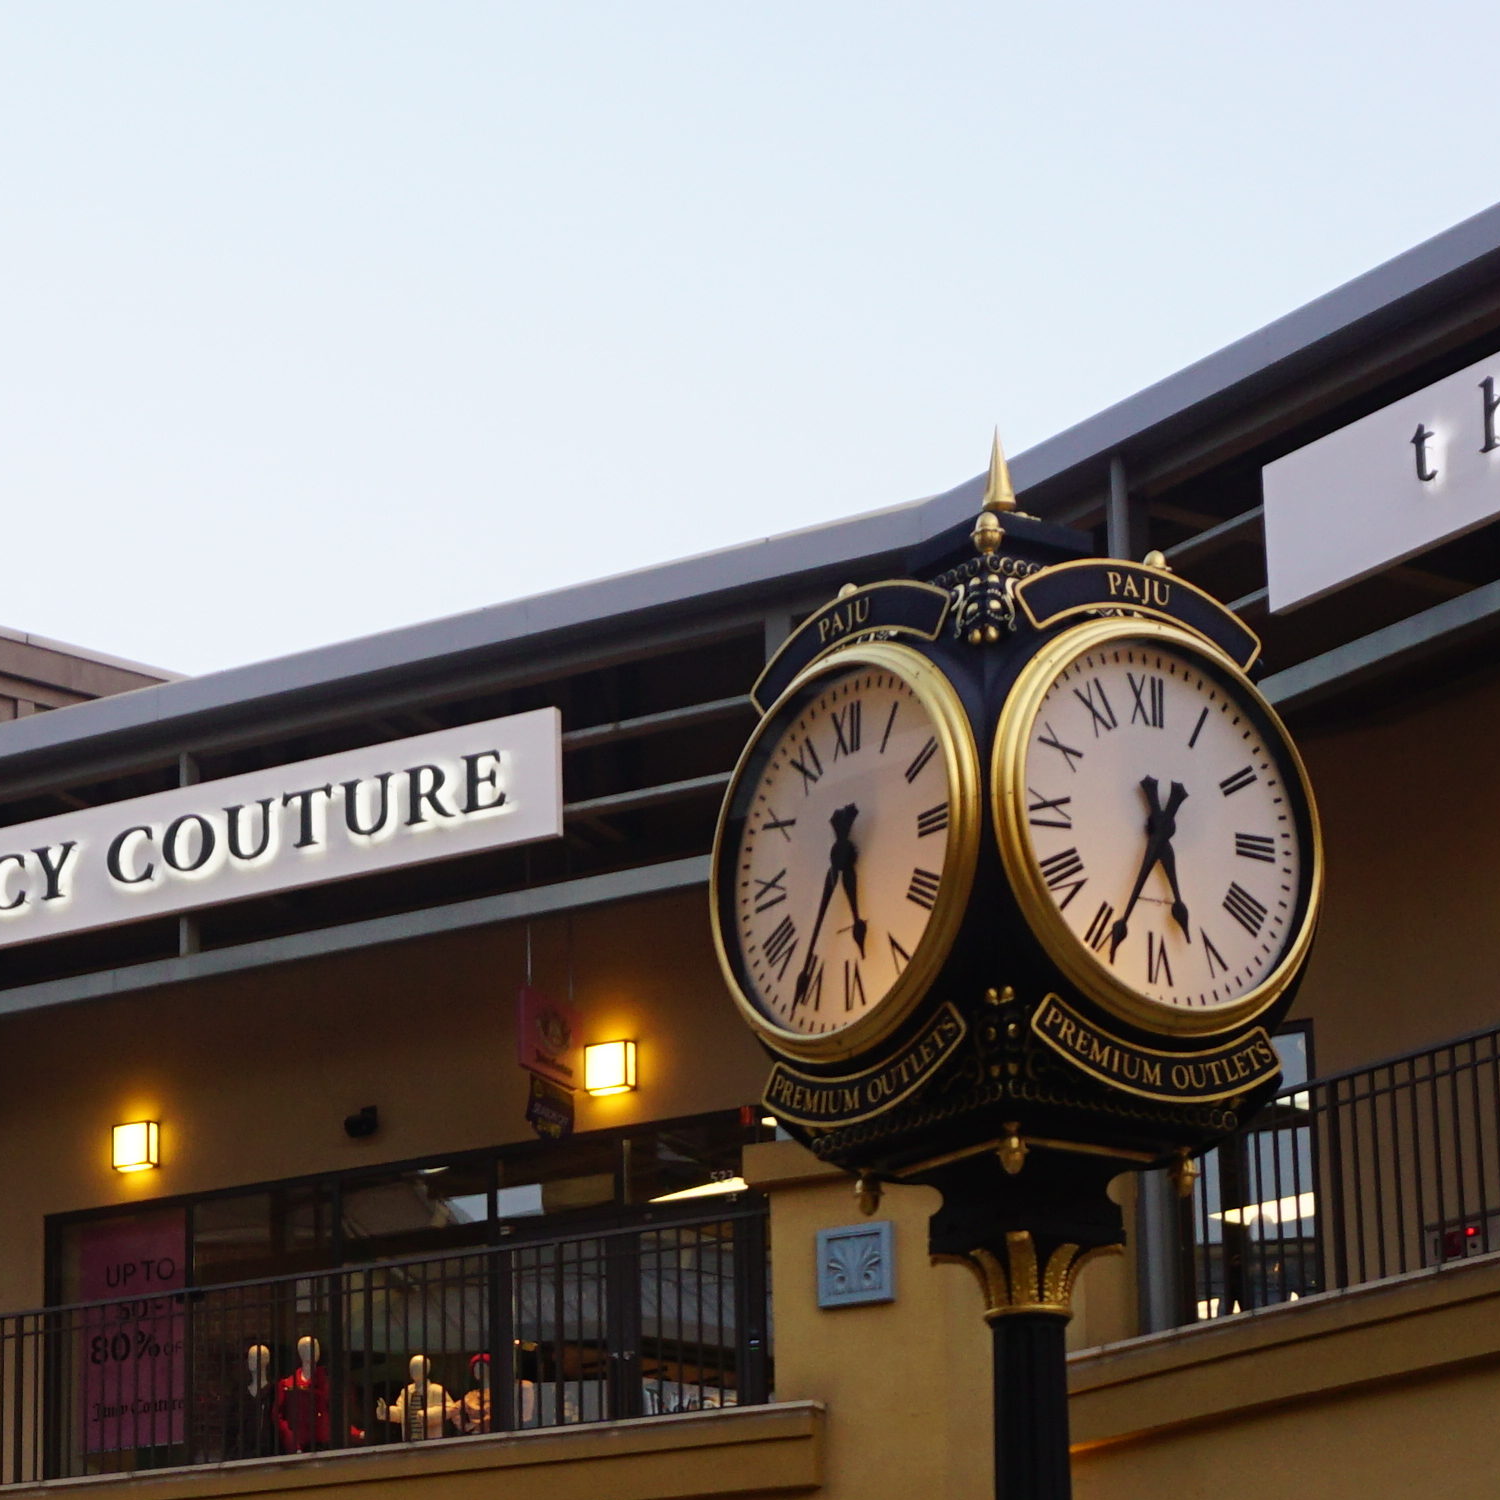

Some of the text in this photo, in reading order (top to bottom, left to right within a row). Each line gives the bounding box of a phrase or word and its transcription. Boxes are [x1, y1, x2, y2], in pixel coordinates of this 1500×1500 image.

[1106, 571, 1171, 607] PAJU
[817, 597, 870, 644] PAJU
[1073, 677, 1118, 738] XI
[1126, 672, 1164, 729] XII
[832, 700, 861, 763] XII
[1037, 721, 1083, 773] X
[790, 735, 824, 797] XI
[904, 735, 939, 784] II
[1219, 764, 1258, 797] II
[107, 748, 507, 885] COUTURE
[762, 807, 796, 843] X
[917, 801, 949, 838] III
[1028, 787, 1072, 829] IX
[1234, 832, 1276, 864] III
[754, 867, 788, 914] IX
[887, 931, 911, 976] V
[1148, 930, 1174, 988] VI
[1199, 926, 1229, 979] V
[845, 959, 867, 1012] VI
[770, 1014, 956, 1115] PREMIUM OUTLETS
[1043, 1006, 1273, 1090] PREMIUM OUTLETS
[105, 1257, 175, 1288] UP TO
[90, 1330, 161, 1365] 80%
